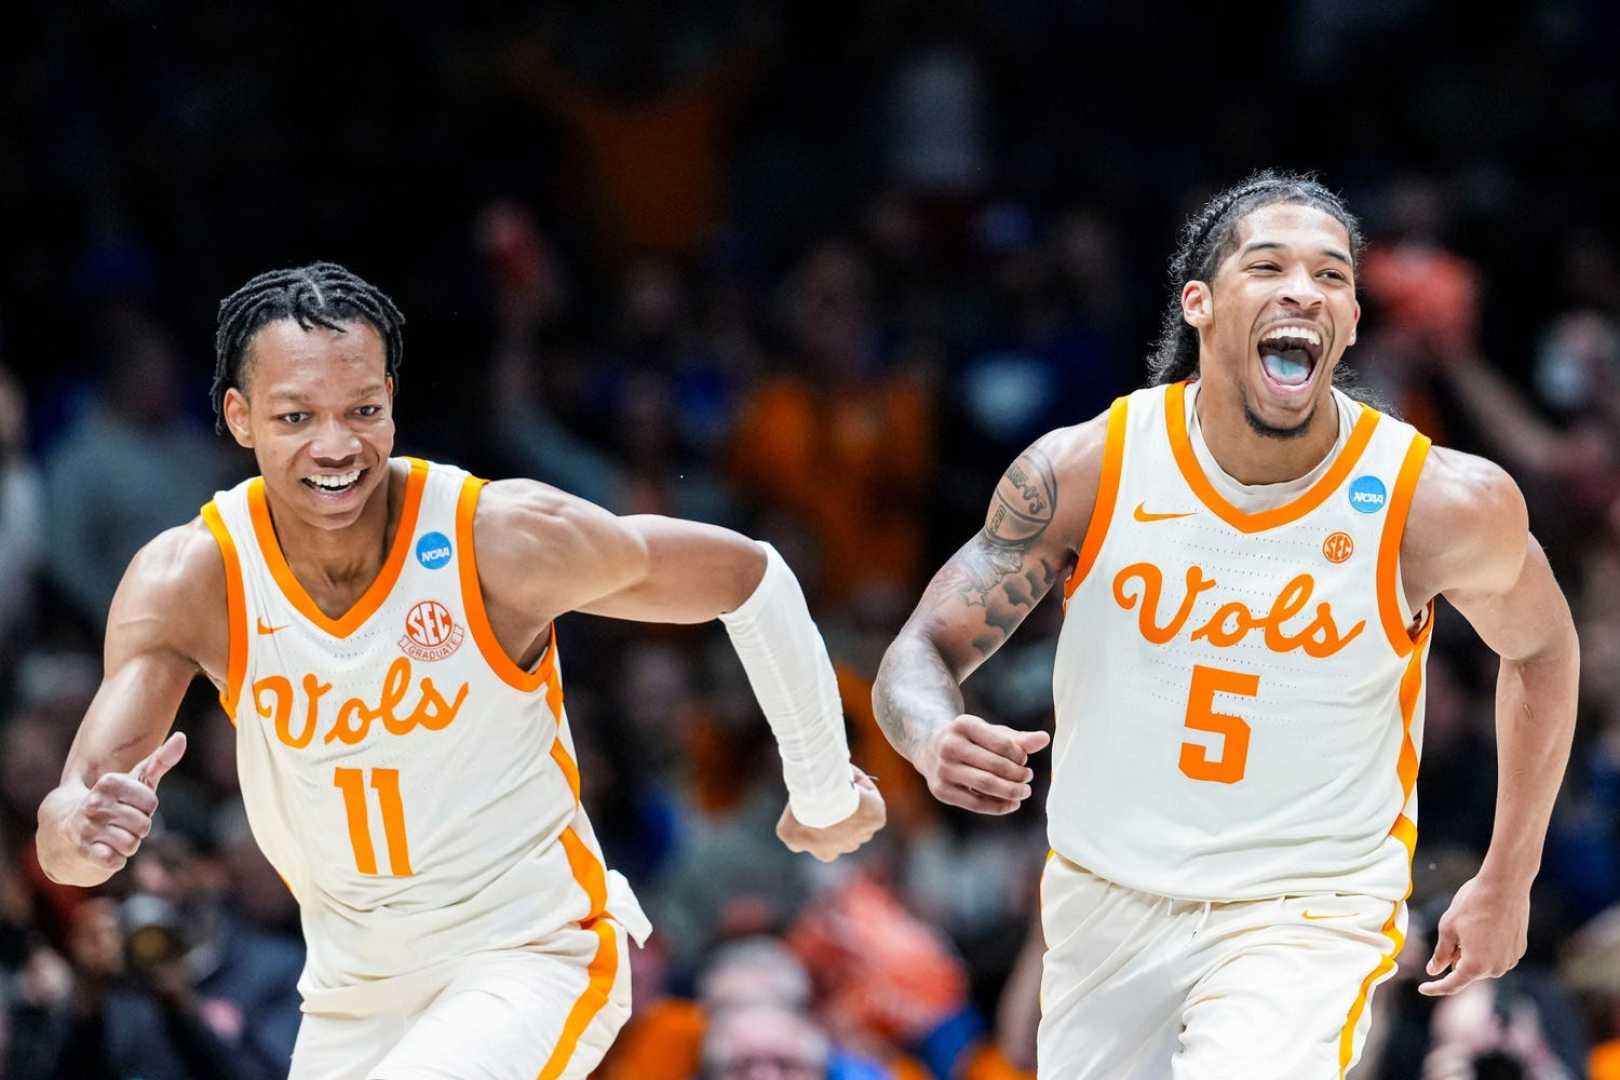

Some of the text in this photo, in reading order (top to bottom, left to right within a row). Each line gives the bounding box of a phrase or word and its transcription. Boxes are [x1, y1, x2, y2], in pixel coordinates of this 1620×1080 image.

[1353, 491, 1385, 505] NCAA
[421, 546, 450, 563] NCAA
[1325, 534, 1352, 562] SEC
[407, 602, 452, 647] SEC
[1112, 563, 1366, 658] Vols
[408, 638, 457, 660] GRADUATE
[253, 656, 469, 749] Vols
[1179, 664, 1260, 785] 5
[334, 767, 416, 877] 11
